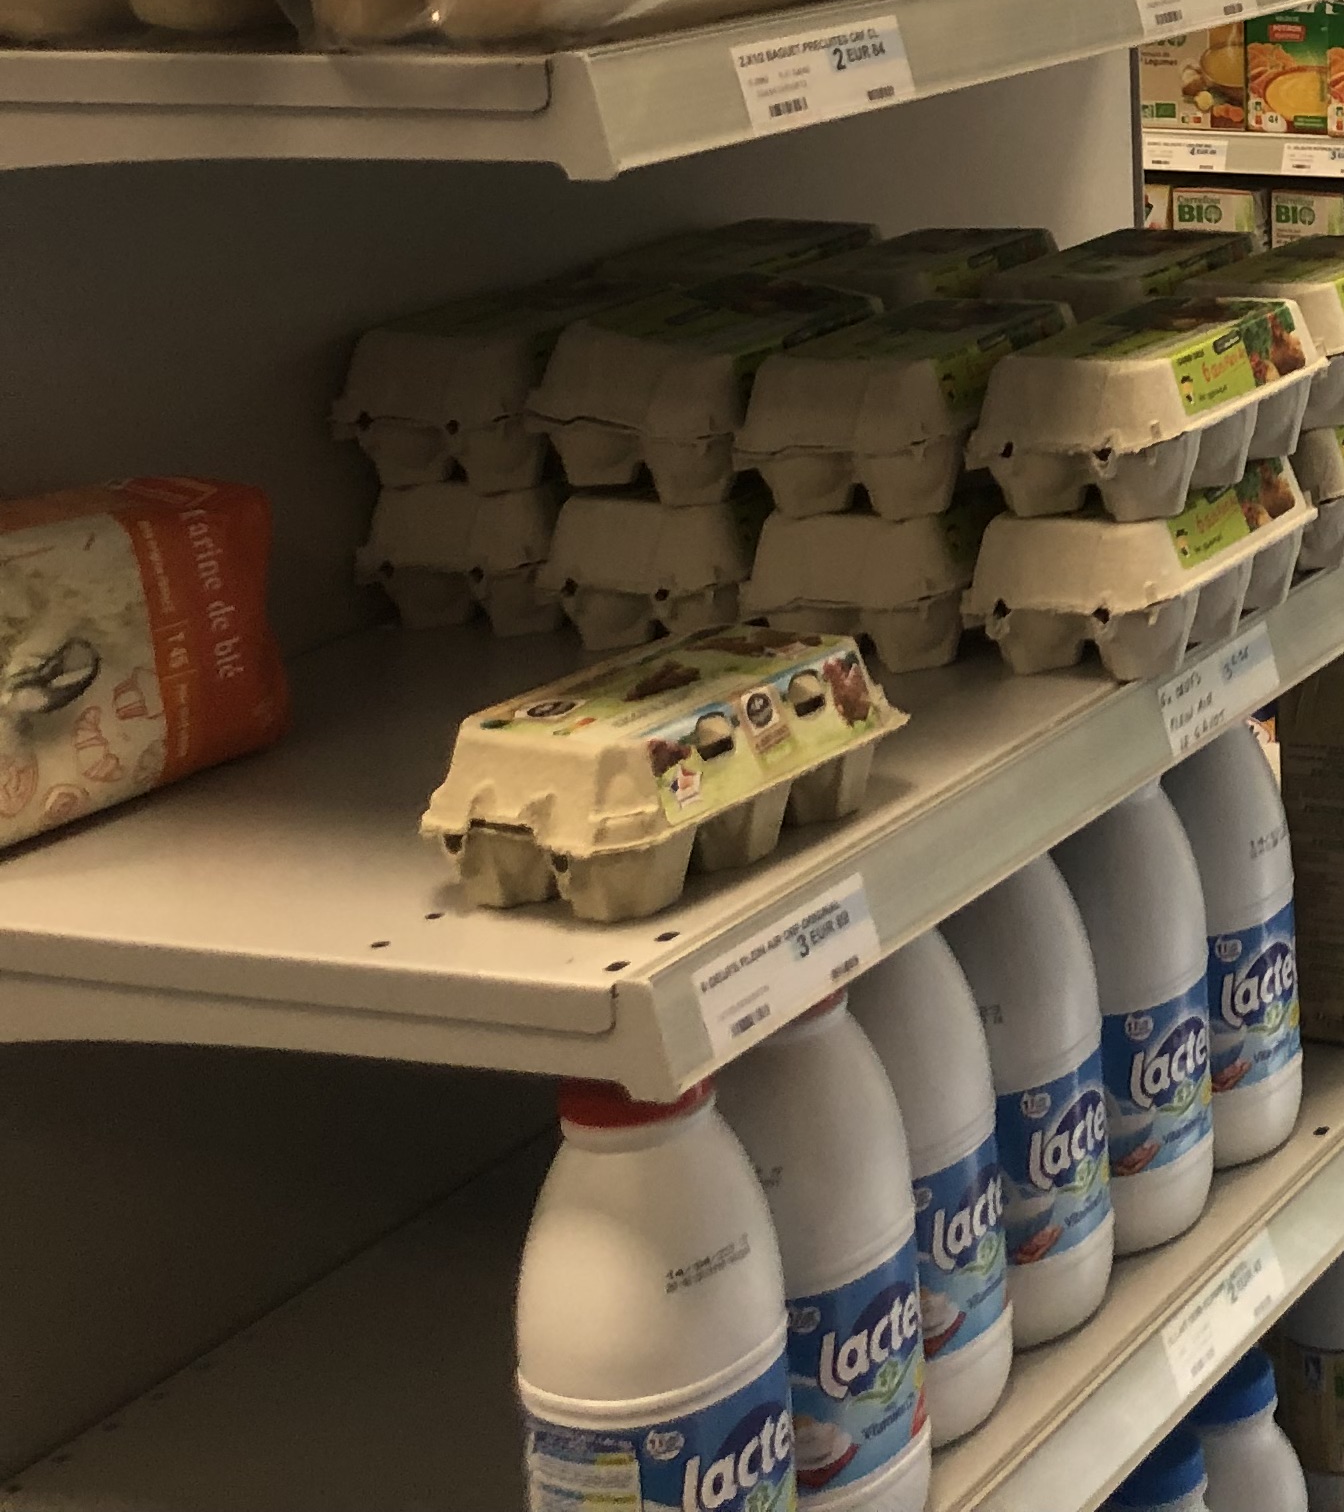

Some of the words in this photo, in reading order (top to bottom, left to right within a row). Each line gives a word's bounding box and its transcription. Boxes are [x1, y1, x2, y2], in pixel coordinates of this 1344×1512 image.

[832, 47, 847, 71] 2
[847, 44, 869, 63] EUR
[1177, 205, 1223, 224] BIO
[1275, 205, 1316, 225] BIO
[206, 600, 236, 633] de
[214, 636, 245, 680] blé
[796, 934, 810, 958] 3
[809, 919, 834, 946] EUR
